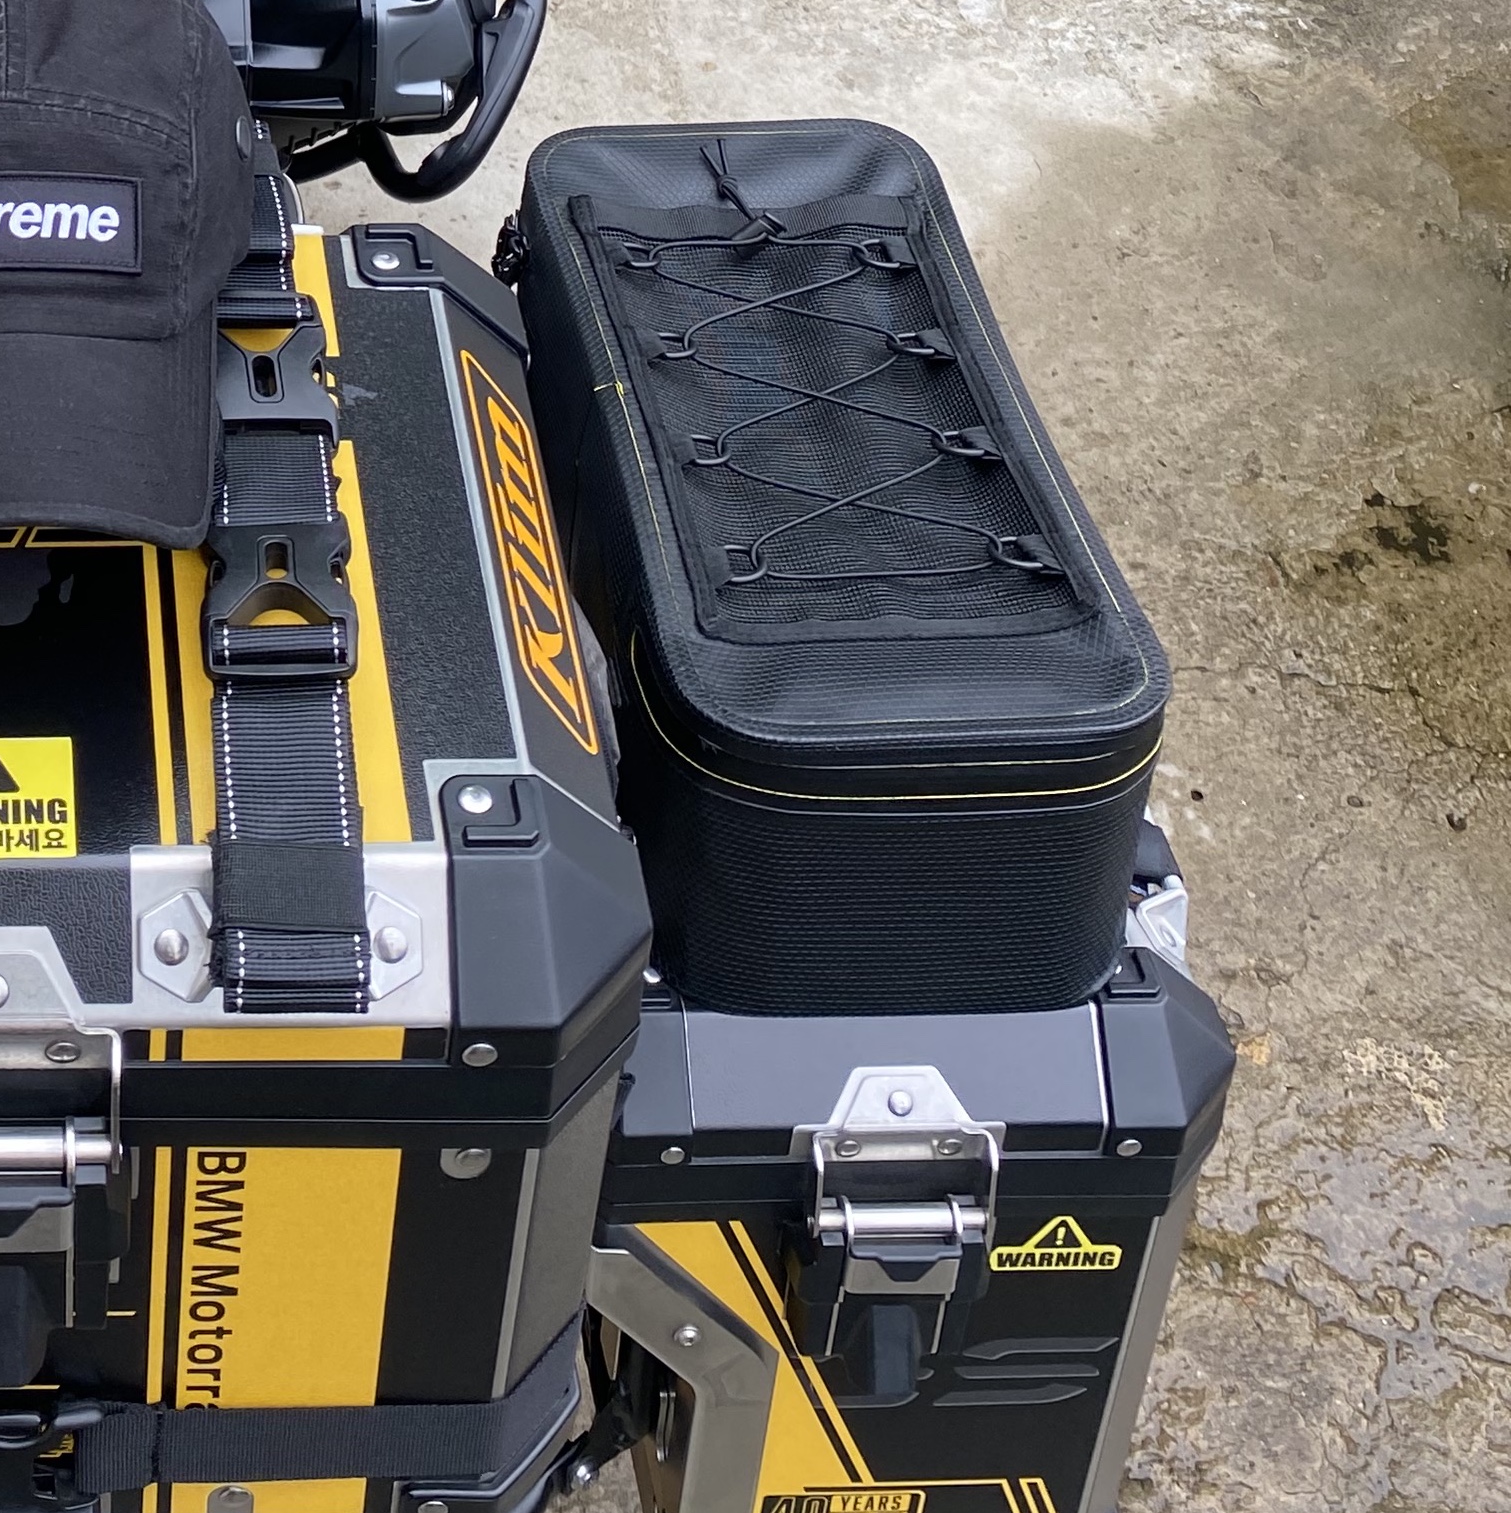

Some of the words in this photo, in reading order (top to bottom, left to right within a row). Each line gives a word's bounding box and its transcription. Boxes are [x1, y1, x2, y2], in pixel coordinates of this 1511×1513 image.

[192, 1151, 247, 1254] BMW
[996, 1251, 1116, 1268] WARNING
[841, 1495, 903, 1511] YEARS
